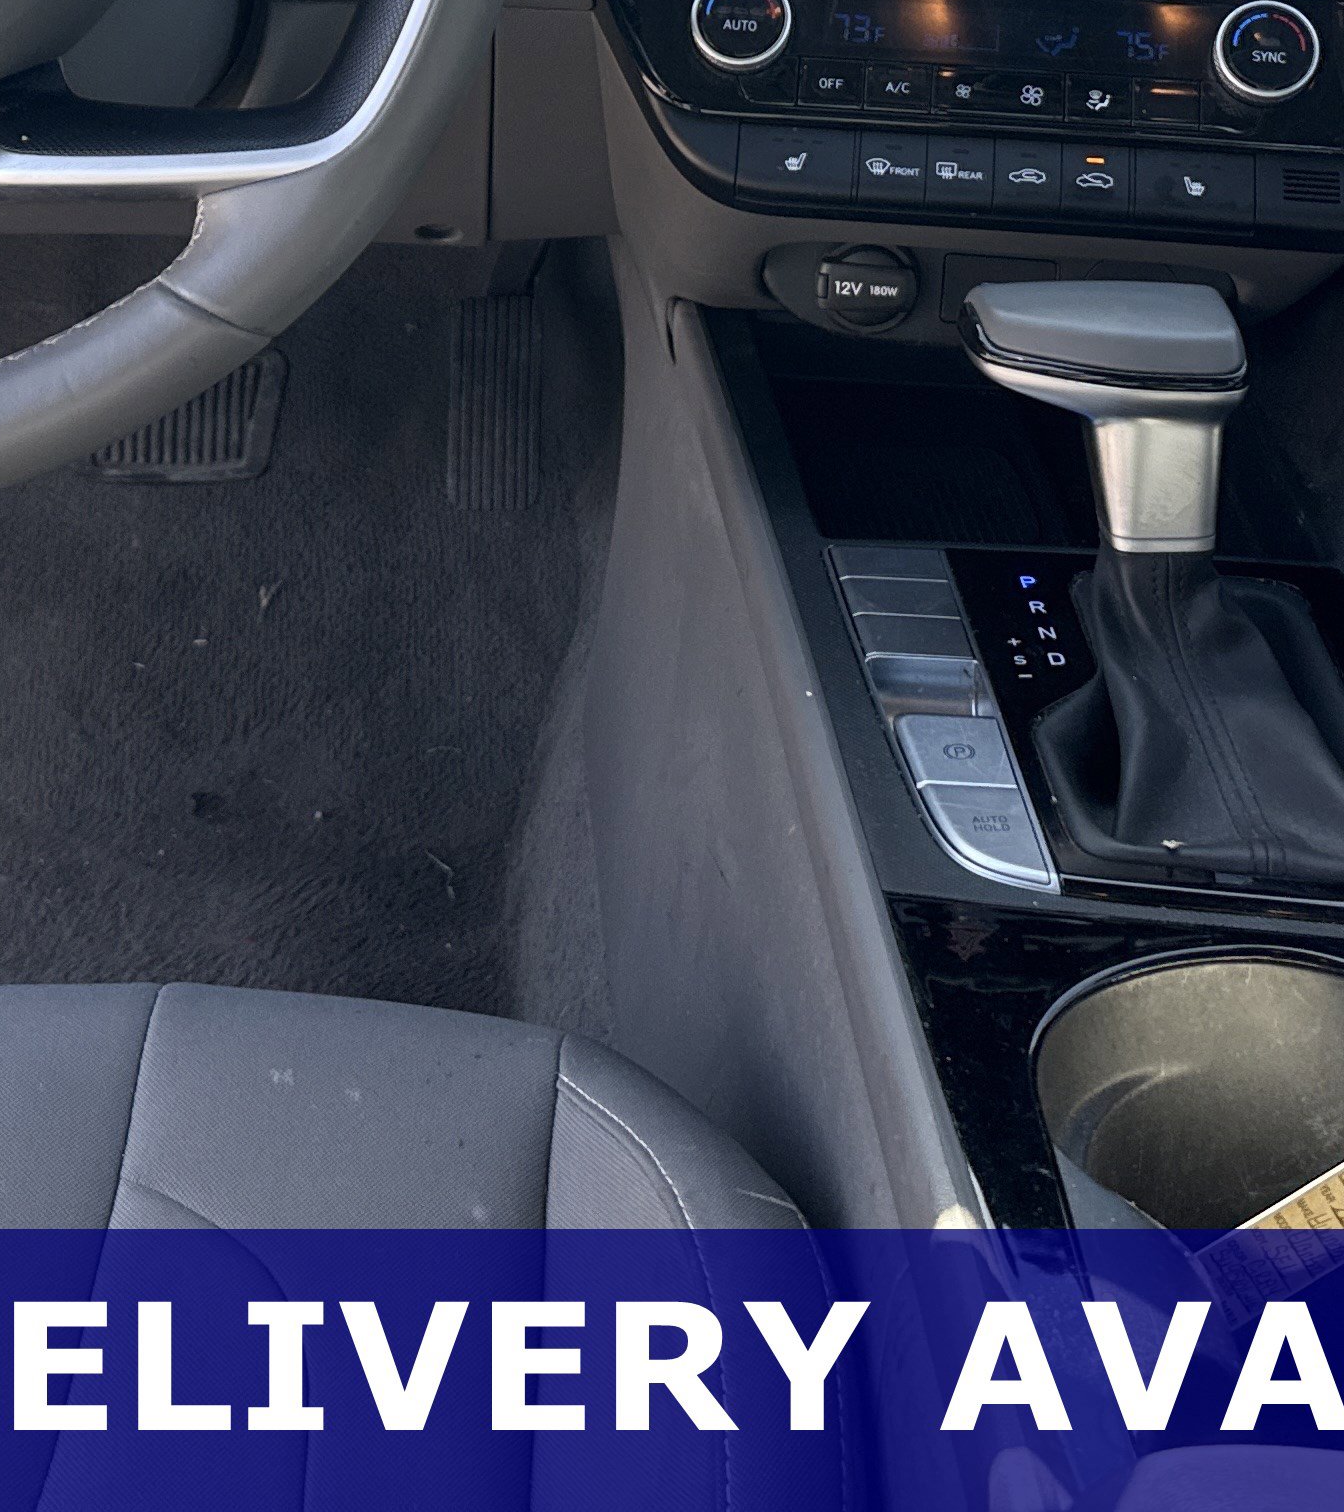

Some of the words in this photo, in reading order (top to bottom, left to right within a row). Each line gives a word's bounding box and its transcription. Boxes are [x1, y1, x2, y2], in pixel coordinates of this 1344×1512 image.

[723, 19, 757, 34] AUTO
[1251, 49, 1288, 65] SYNC
[818, 77, 845, 90] OFF
[885, 80, 911, 94] A/C
[889, 166, 921, 179] FRONT
[957, 170, 983, 183] REAR
[835, 279, 864, 297] 12V
[869, 284, 899, 298] 180W
[1019, 575, 1036, 589] P
[1028, 600, 1047, 614] R
[1037, 626, 1057, 640] N
[1013, 655, 1027, 666] S
[1047, 651, 1066, 666] D
[972, 815, 1008, 824] AUTO
[973, 823, 1011, 832] HOLD
